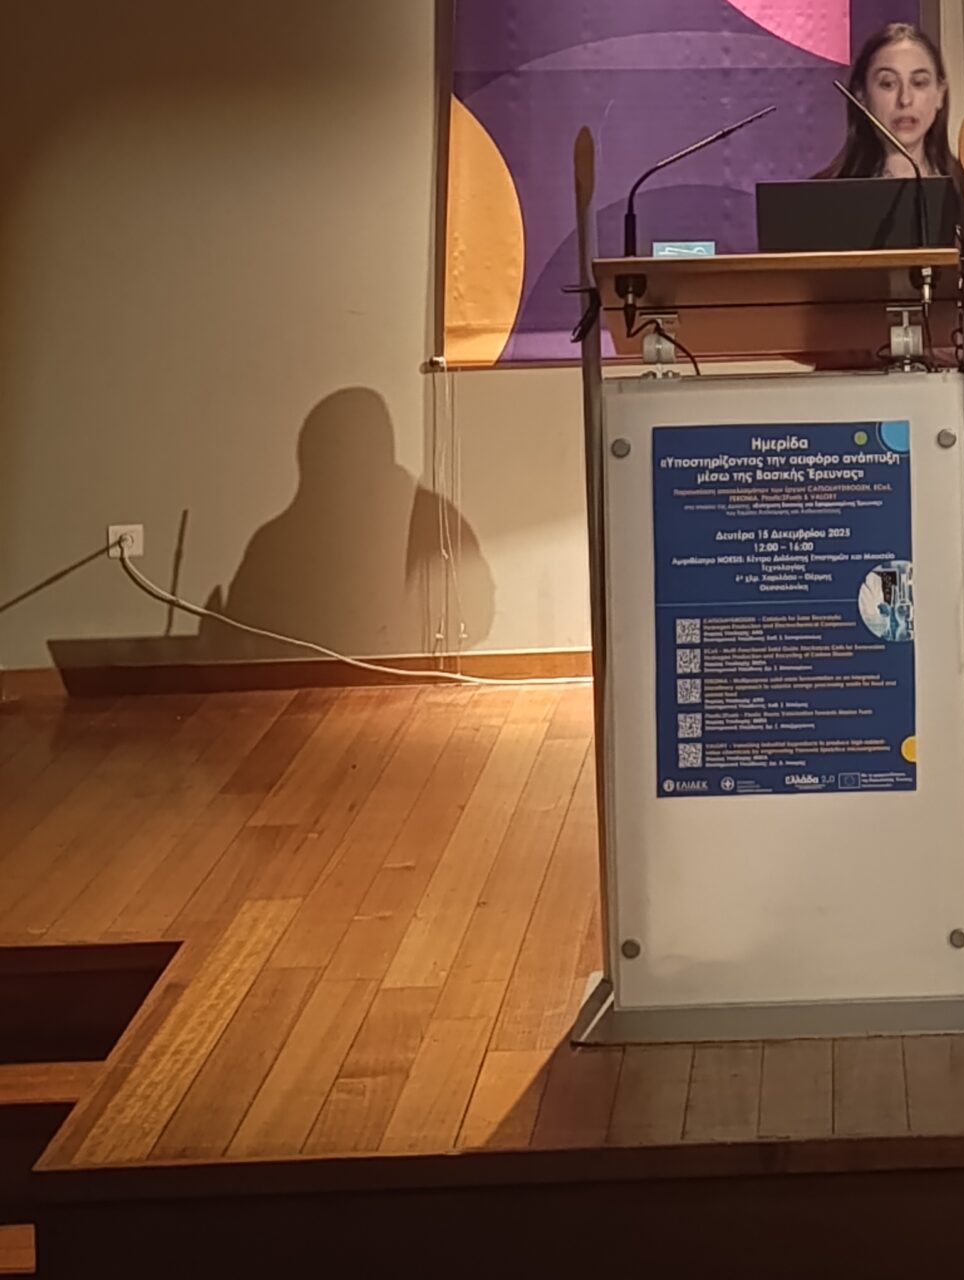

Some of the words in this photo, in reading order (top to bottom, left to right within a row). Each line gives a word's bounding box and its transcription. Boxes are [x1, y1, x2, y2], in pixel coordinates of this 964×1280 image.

[751, 436, 808, 452] Ημερίδα
[767, 456, 787, 467] την
[697, 470, 730, 484] μέσω
[733, 471, 753, 483] της
[756, 468, 804, 482] Βασικής
[715, 530, 755, 541] Δευτέρα
[758, 530, 769, 539] 15
[771, 528, 826, 540] Δεκεμβρίου
